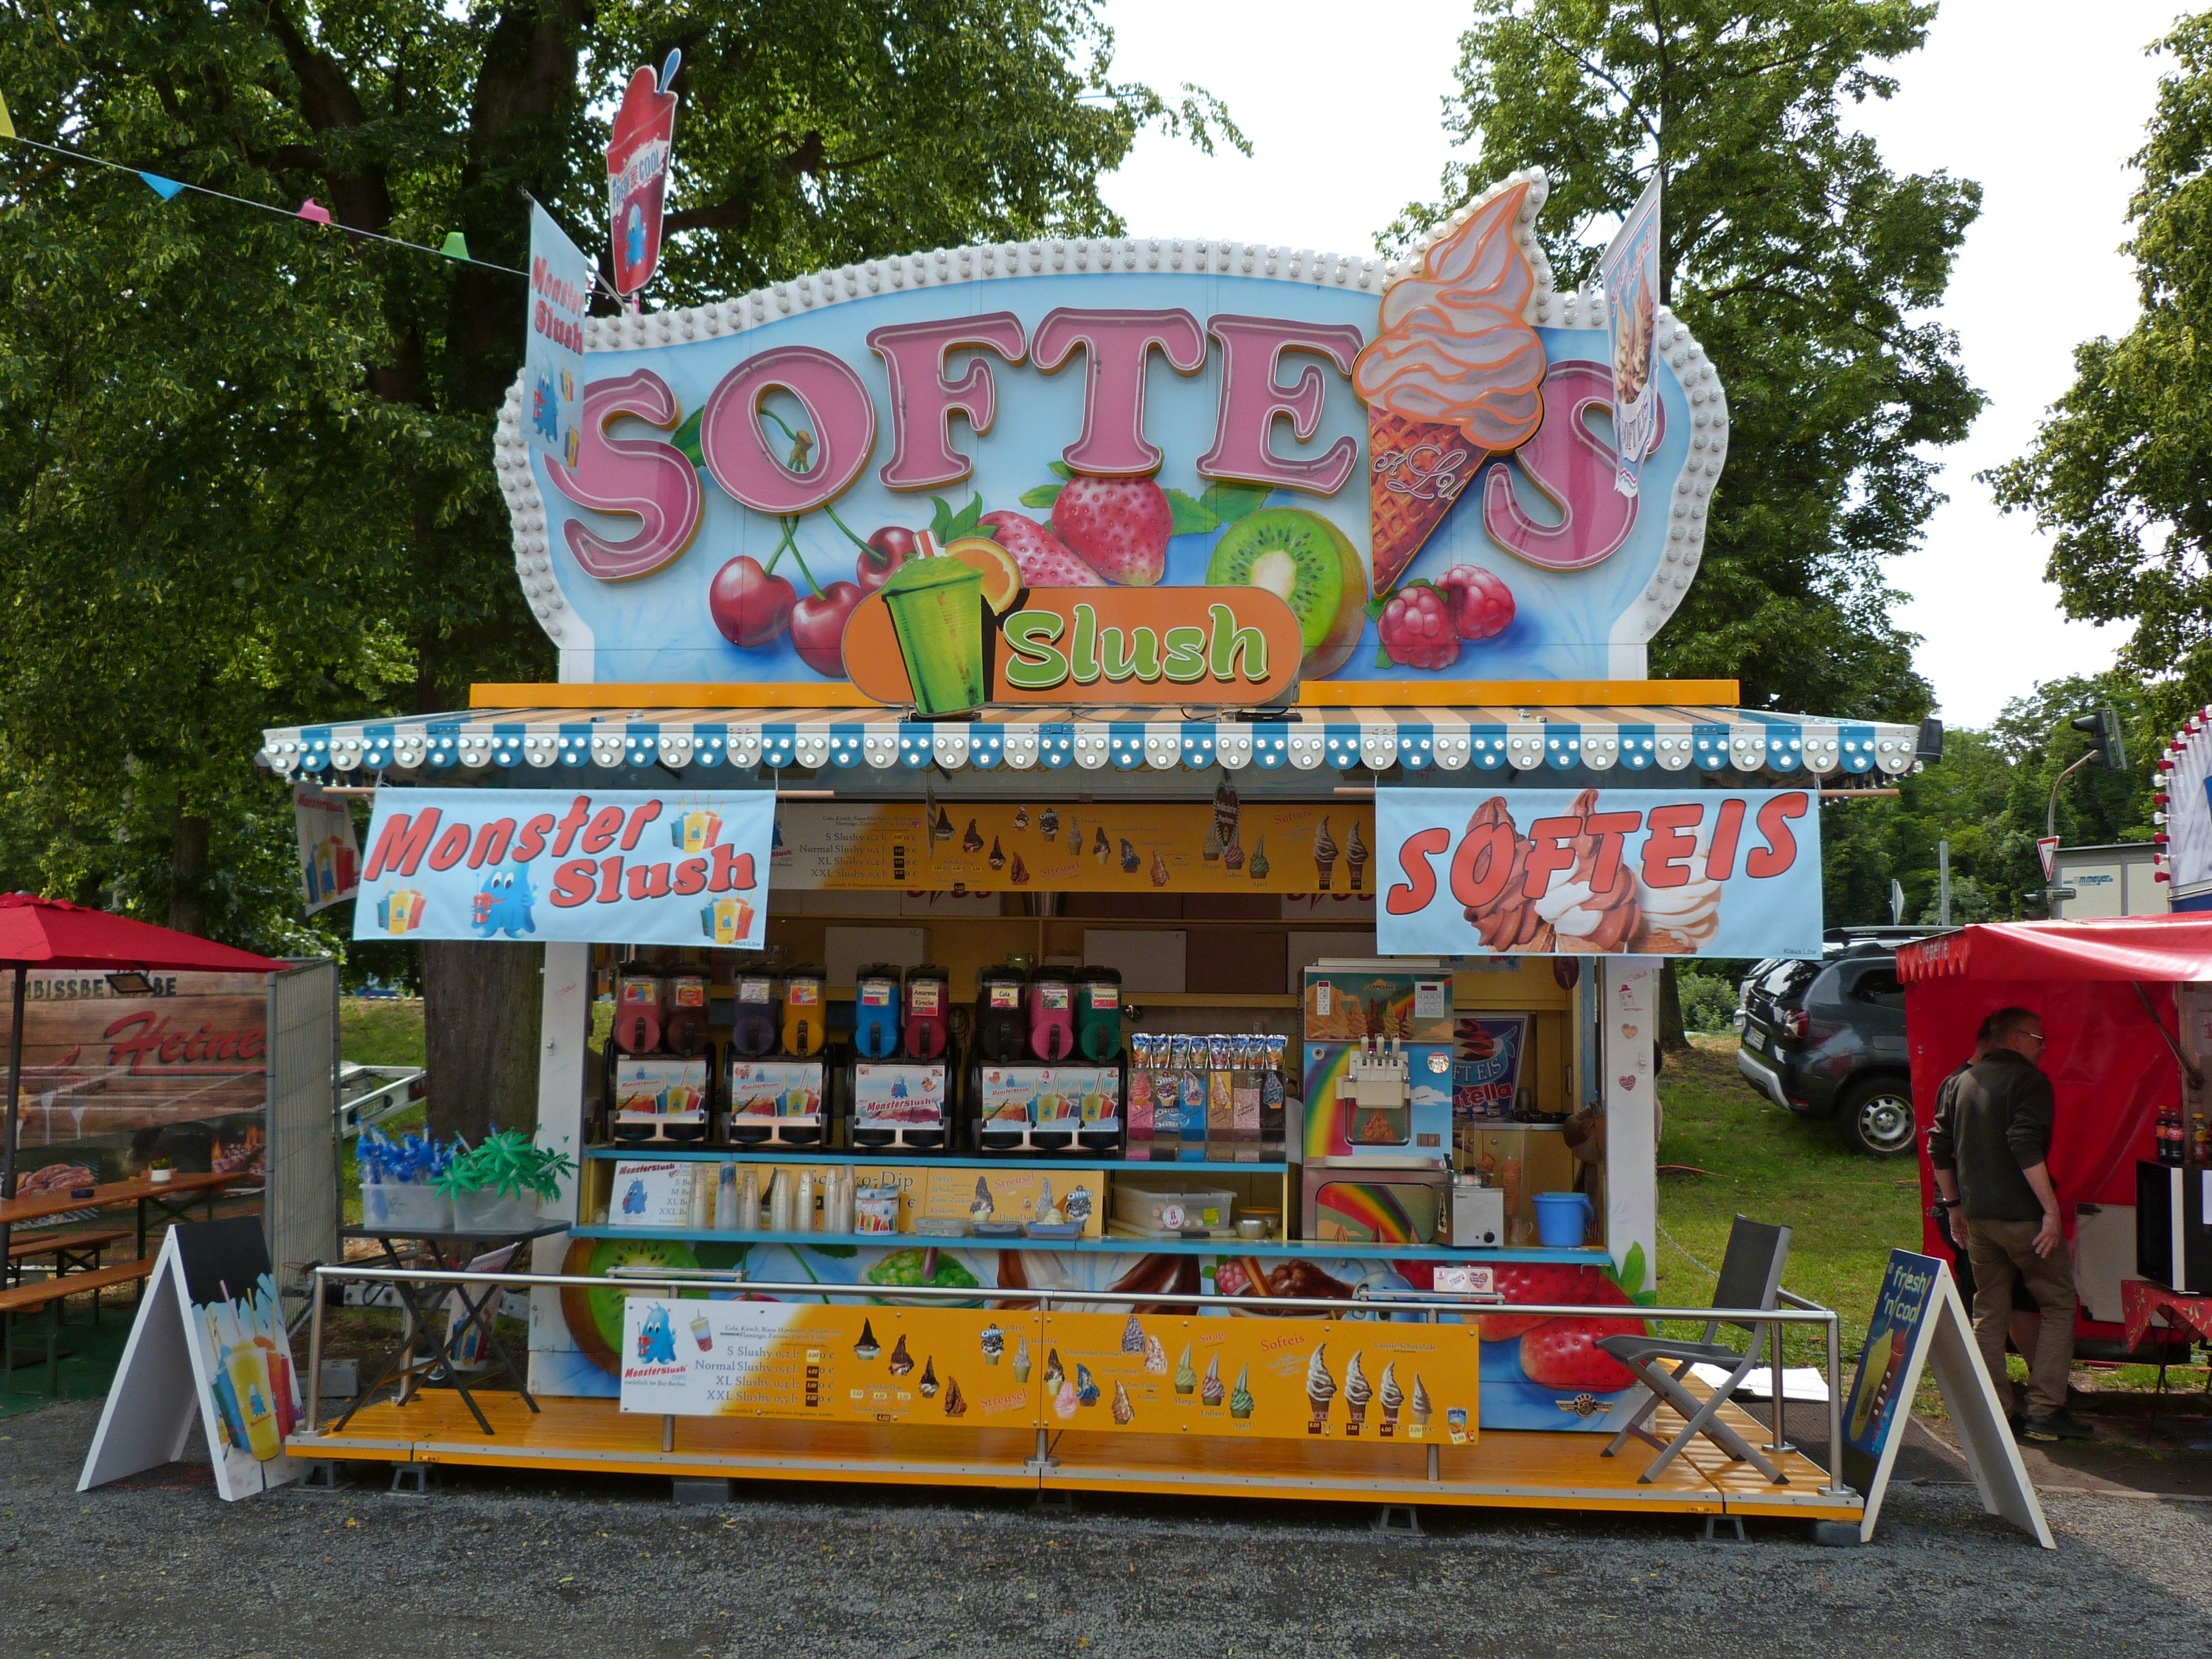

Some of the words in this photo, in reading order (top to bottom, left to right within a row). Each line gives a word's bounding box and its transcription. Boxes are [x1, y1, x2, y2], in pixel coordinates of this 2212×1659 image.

[639, 149, 661, 182] COOL
[531, 255, 585, 318] Monster
[535, 299, 583, 356] Slush
[1004, 603, 1270, 691] Slush
[364, 796, 663, 882] Monster
[834, 833, 863, 843] Slushy
[799, 845, 833, 853] Normal
[835, 846, 864, 855] Slushy
[1386, 791, 1810, 915] SOFTEIS
[818, 857, 832, 865] XL
[835, 858, 863, 867] Slushy
[1040, 860, 1080, 877] Streusel
[549, 844, 757, 908] Slush
[811, 869, 832, 877] XXL
[835, 869, 865, 880] Slushy
[103, 1010, 267, 1075] Heine
[1453, 1065, 1472, 1081] FT
[1477, 1058, 1502, 1080] EIS
[1155, 1076, 1178, 1086] OREO
[1453, 1082, 1513, 1110] utella
[995, 1172, 1035, 1188] Streusel
[1067, 1189, 1093, 1200] OREO
[907, 1199, 917, 1208] €
[1893, 1265, 1927, 1295] fresh
[1896, 1302, 1921, 1325] cool
[981, 1329, 1004, 1337] OREO
[1199, 1332, 1226, 1343] Sirup:
[1261, 1333, 1305, 1352] Softeis
[727, 1346, 734, 1356] S
[737, 1346, 772, 1359] Slushy
[695, 1360, 735, 1371] Normal
[737, 1360, 772, 1374] Slushy
[716, 1376, 731, 1385] XL
[736, 1376, 771, 1389] Slushy
[707, 1391, 732, 1400] XXL
[737, 1391, 771, 1404] Slushy
[980, 1388, 1027, 1408] Streusel
[1174, 1398, 1196, 1406] Mango
[1352, 1413, 1364, 1421] XL
[1234, 1422, 1251, 1430] Apfel
